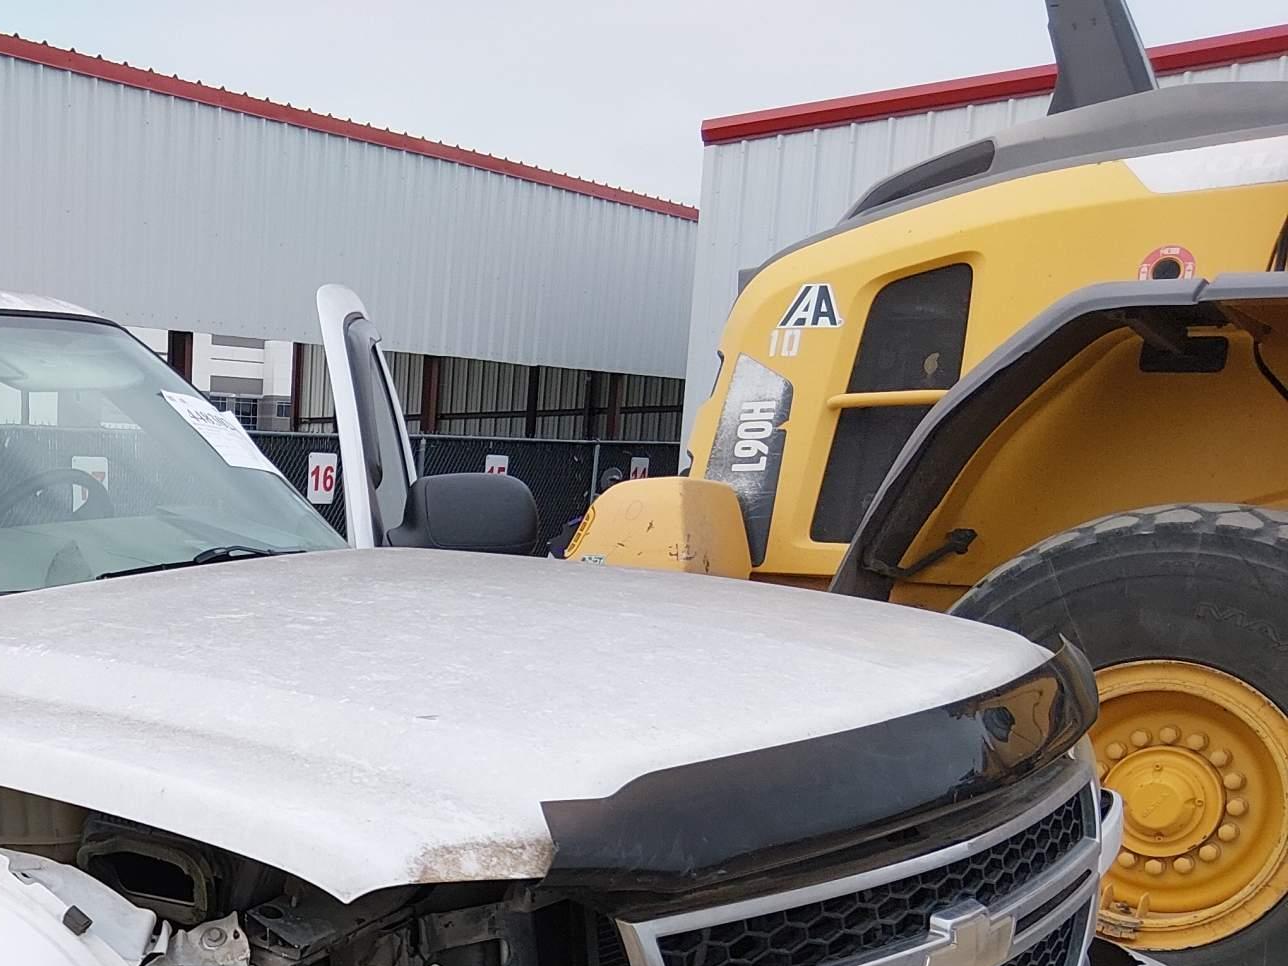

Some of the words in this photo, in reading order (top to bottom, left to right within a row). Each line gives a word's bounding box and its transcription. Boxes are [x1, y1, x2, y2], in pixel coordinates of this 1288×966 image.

[768, 329, 801, 357] 10
[731, 400, 777, 472] L90H
[311, 465, 334, 492] 16
